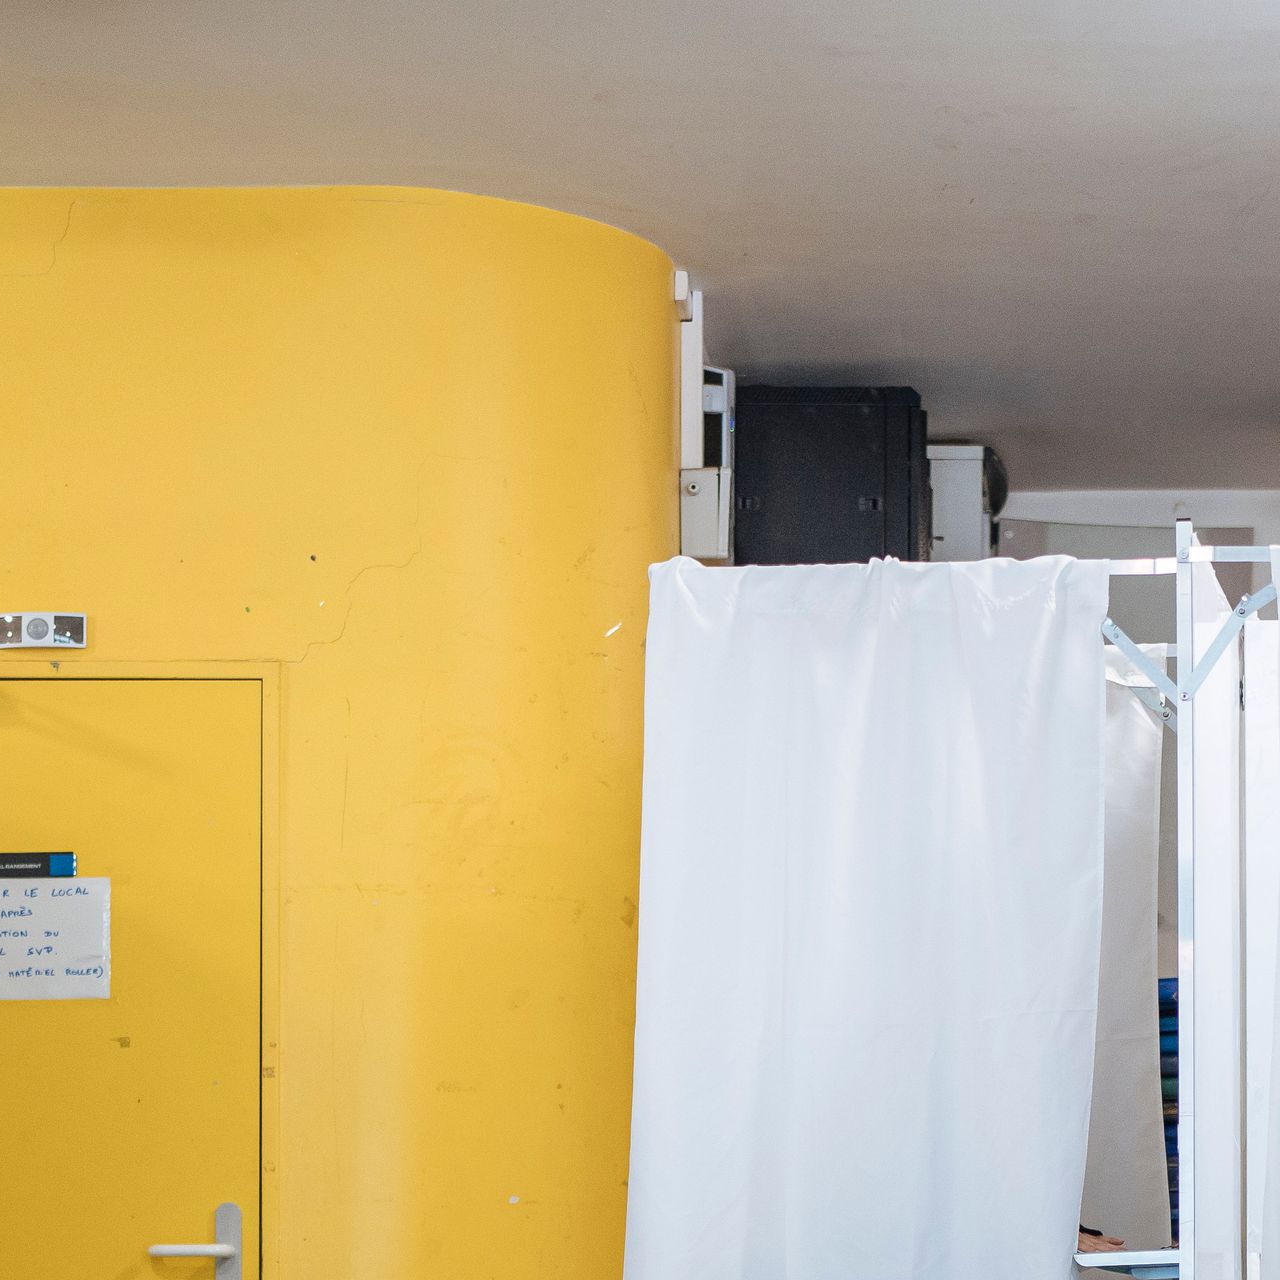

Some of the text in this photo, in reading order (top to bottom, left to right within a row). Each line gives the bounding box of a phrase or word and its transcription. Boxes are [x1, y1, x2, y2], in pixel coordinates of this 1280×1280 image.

[24, 887, 38, 898] LE
[51, 886, 89, 897] LOCAL
[0, 906, 33, 919] APRÈS
[44, 930, 60, 938] DU
